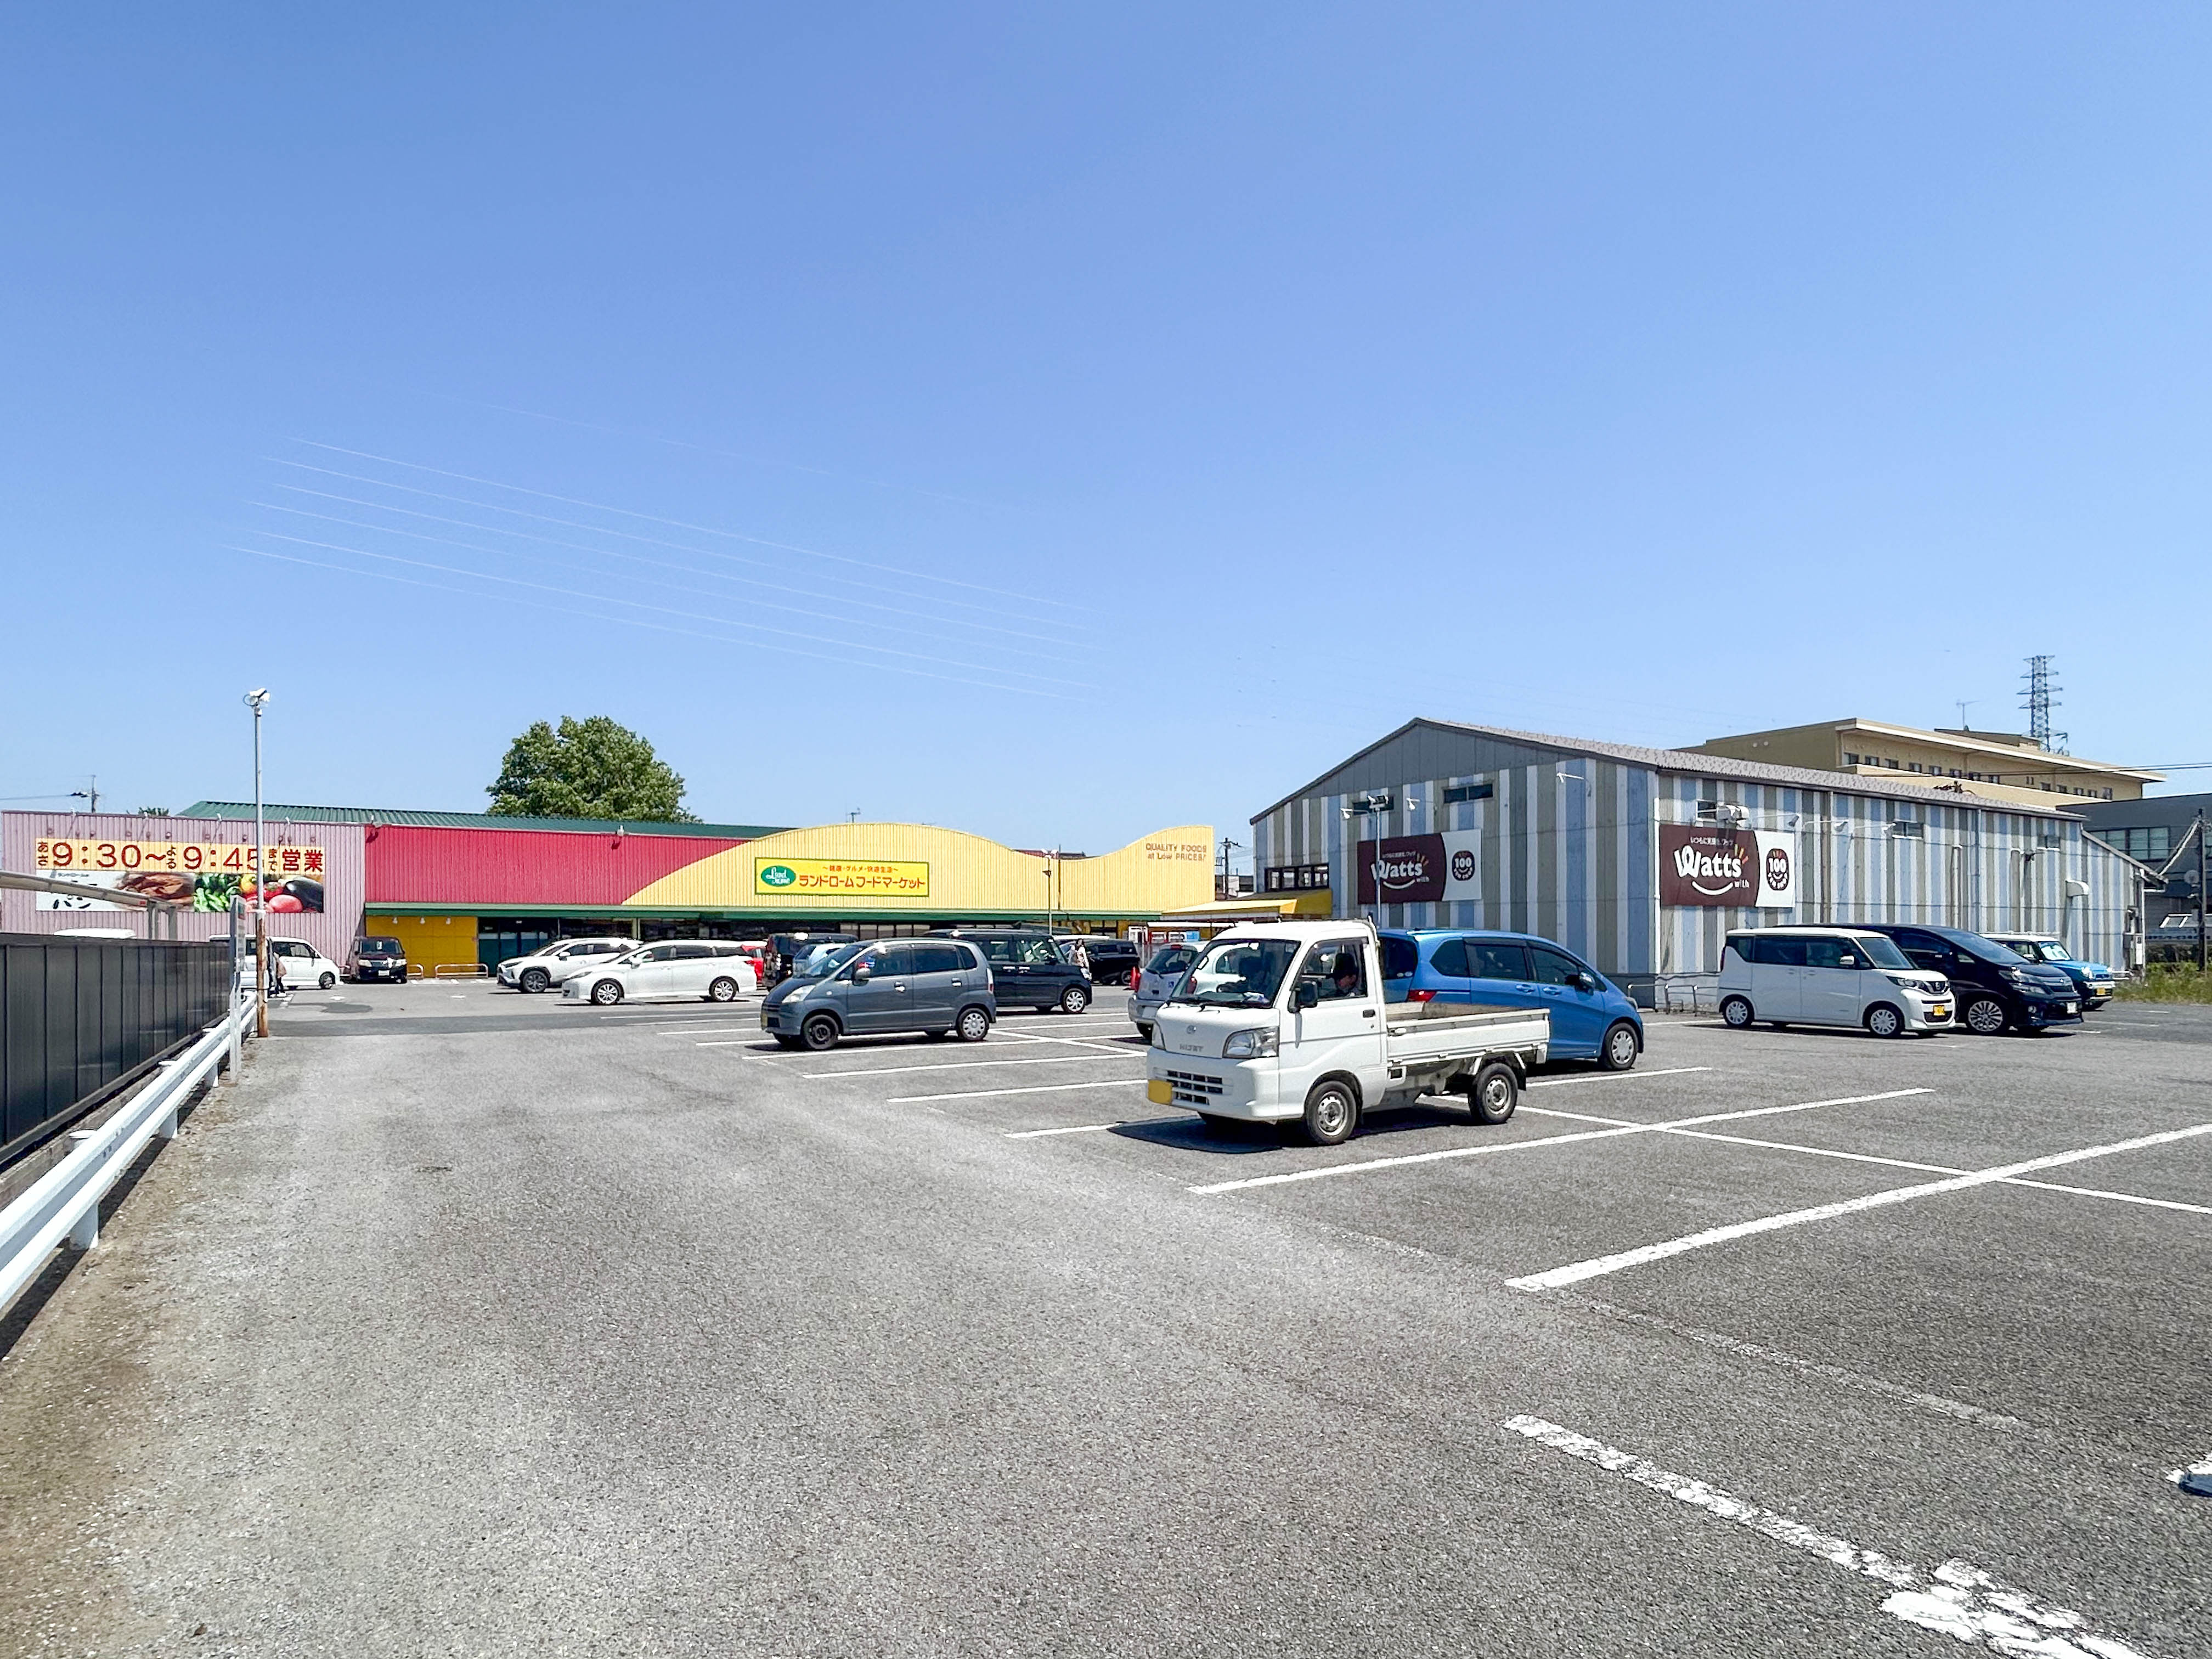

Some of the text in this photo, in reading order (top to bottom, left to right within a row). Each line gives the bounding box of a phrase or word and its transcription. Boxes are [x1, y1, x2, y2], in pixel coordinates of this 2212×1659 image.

[1146, 843, 1177, 851] QUALITY
[1455, 857, 1472, 868] 100
[1674, 845, 1741, 878] Watts
[1768, 857, 1787, 872] 100
[1370, 859, 1423, 880] Watts
